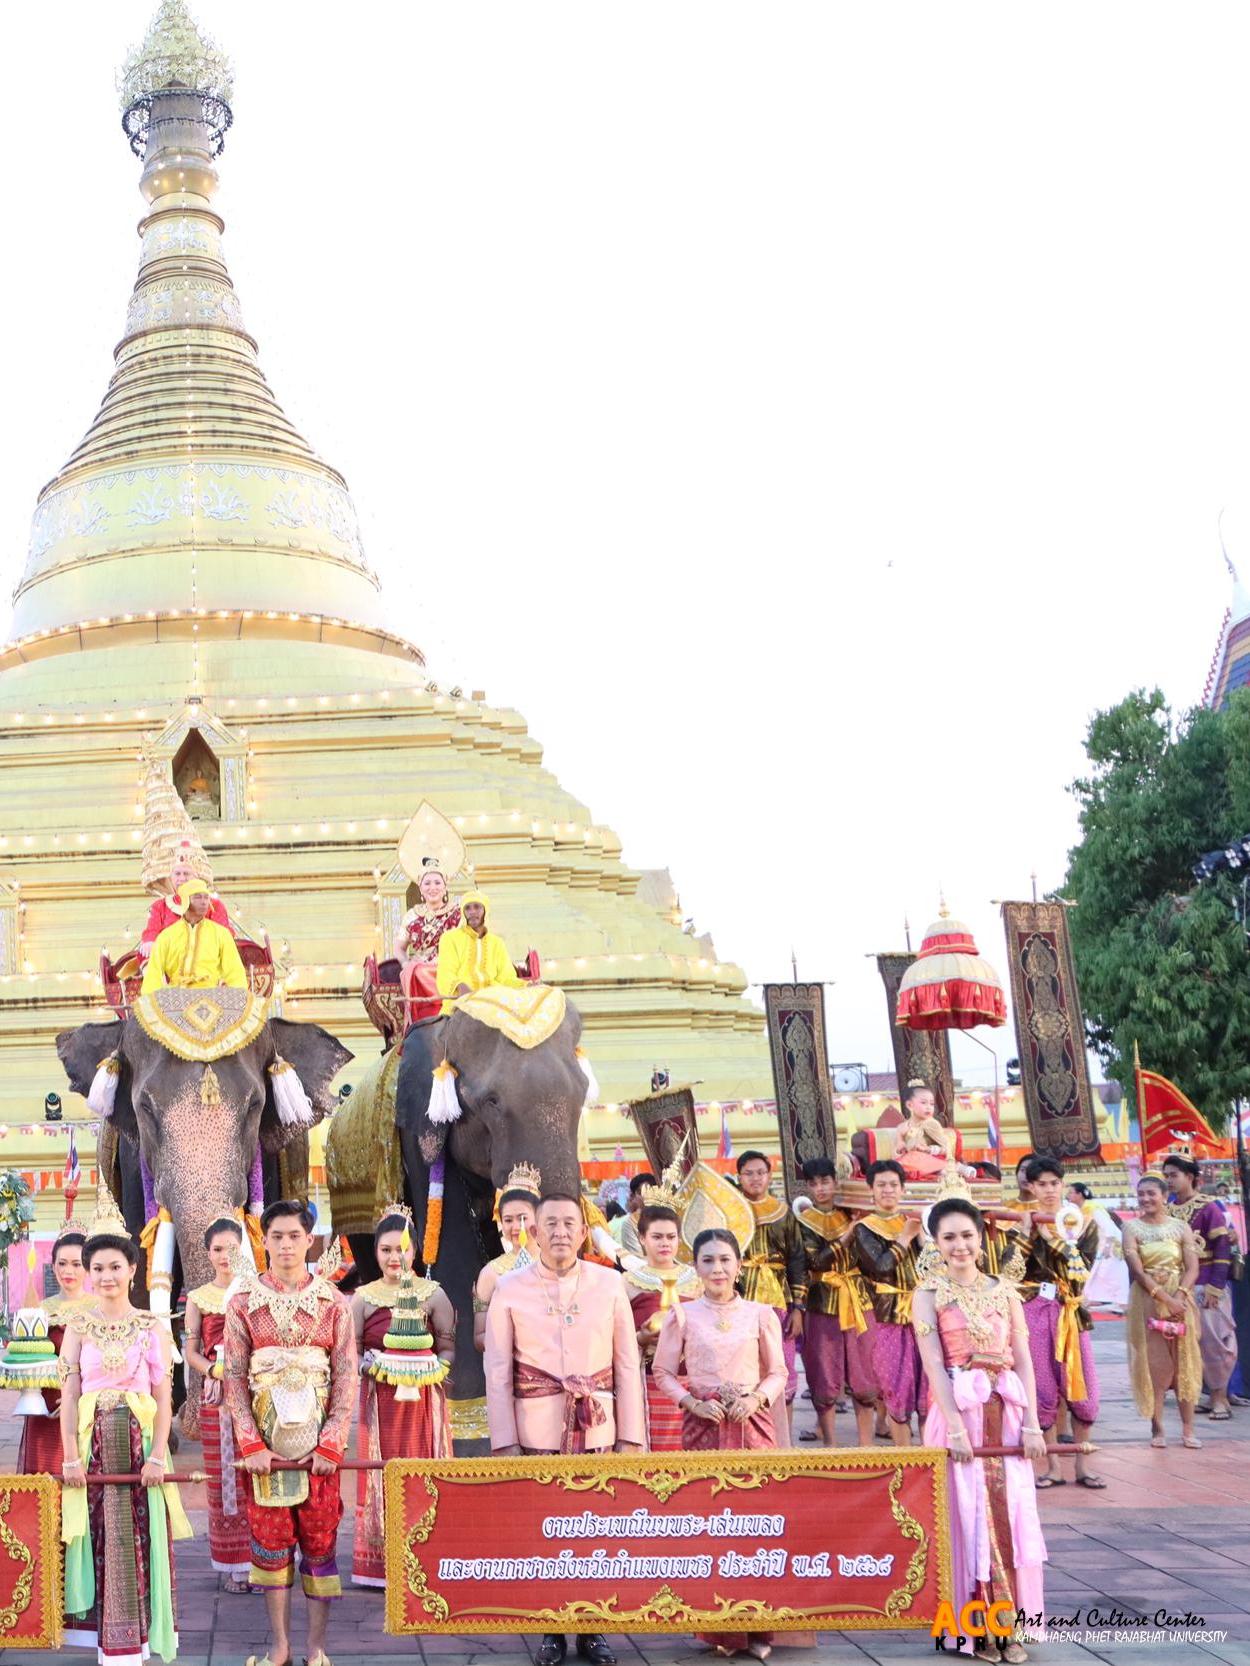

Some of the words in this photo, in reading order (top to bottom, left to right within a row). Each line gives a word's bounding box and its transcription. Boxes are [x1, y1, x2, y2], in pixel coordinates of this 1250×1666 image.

[542, 1508, 785, 1538] งานประเพณีนบพระ-เล่นเพลง
[438, 1550, 713, 1579] และงานกาชาดจังหวัดกำแพงเพชร
[718, 1548, 787, 1577] ประจำปี
[792, 1552, 831, 1577] พ.ศ.
[837, 1554, 894, 1577] ๒๕๖๘
